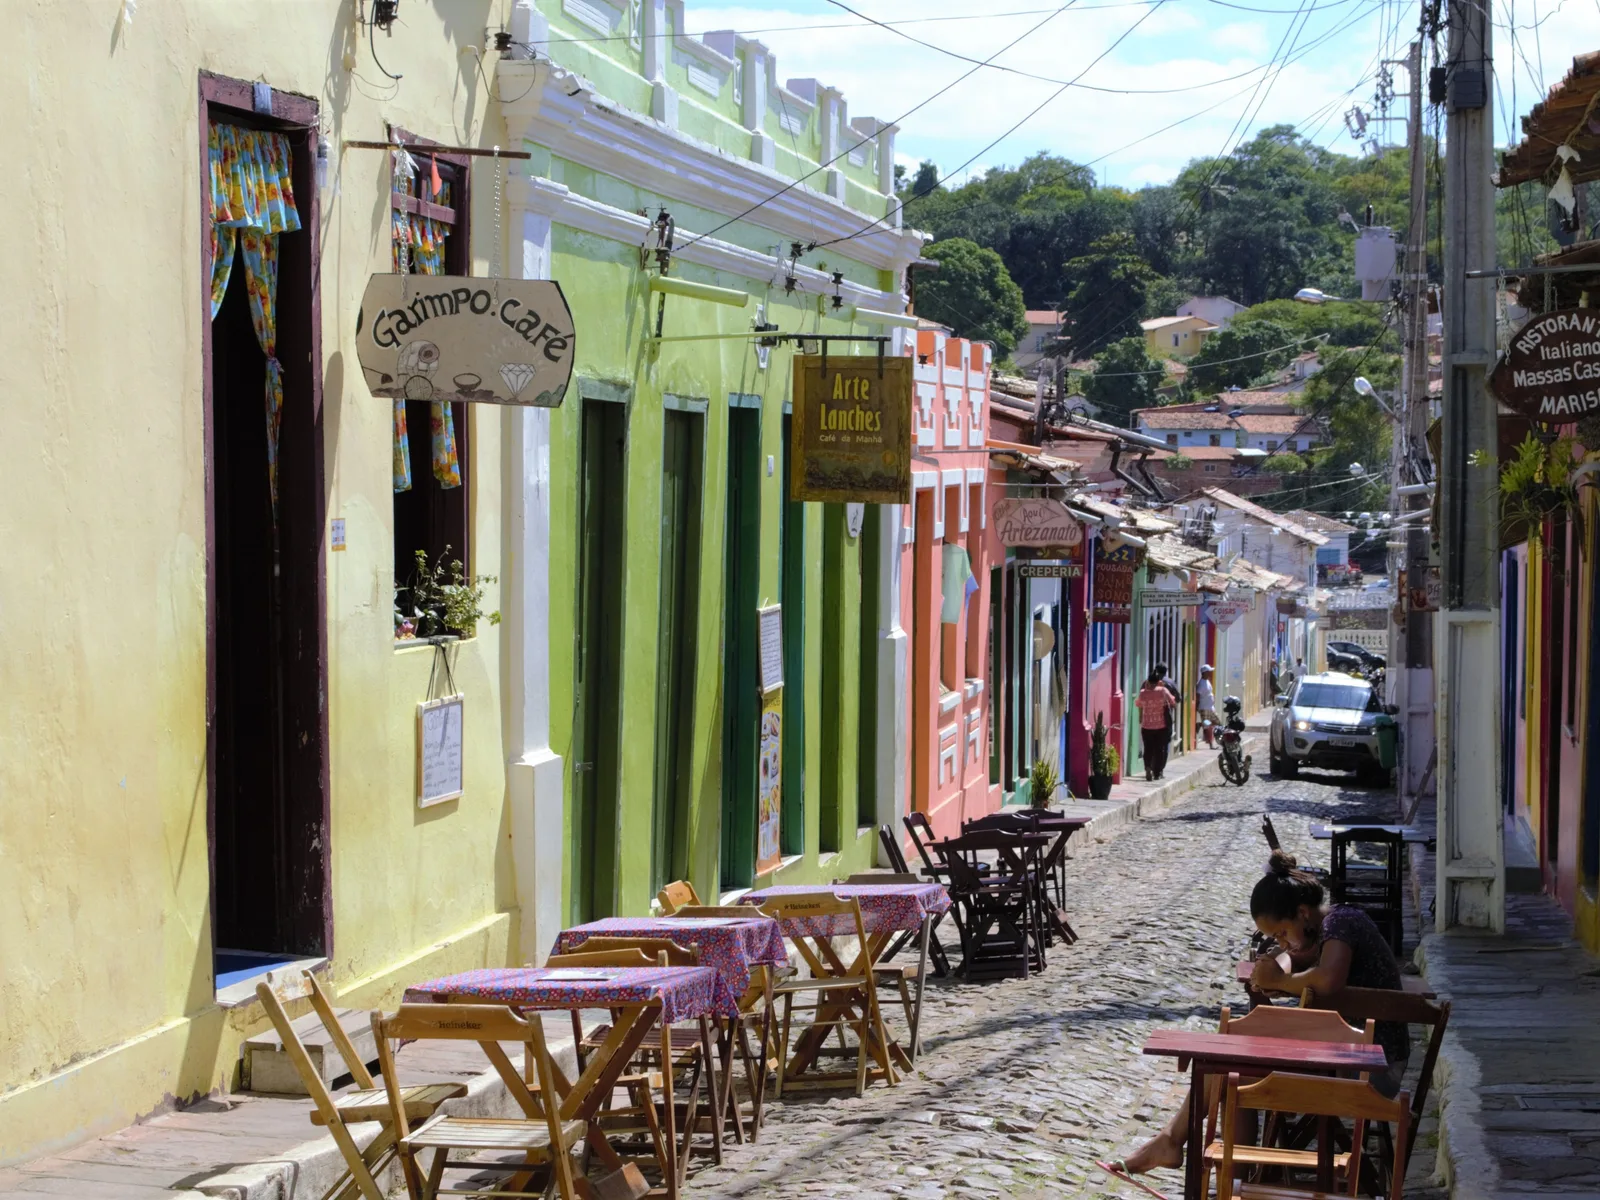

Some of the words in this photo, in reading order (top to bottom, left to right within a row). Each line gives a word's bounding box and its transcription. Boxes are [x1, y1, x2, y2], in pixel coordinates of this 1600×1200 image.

[1540, 340, 1600, 361] Italiano
[832, 373, 870, 400] Arte
[1514, 366, 1572, 388] Massas
[1539, 388, 1600, 416] MARIS
[820, 403, 882, 432] Lanches
[819, 433, 836, 443] Café
[841, 434, 851, 443] da
[1019, 565, 1081, 577] CREPERIA
